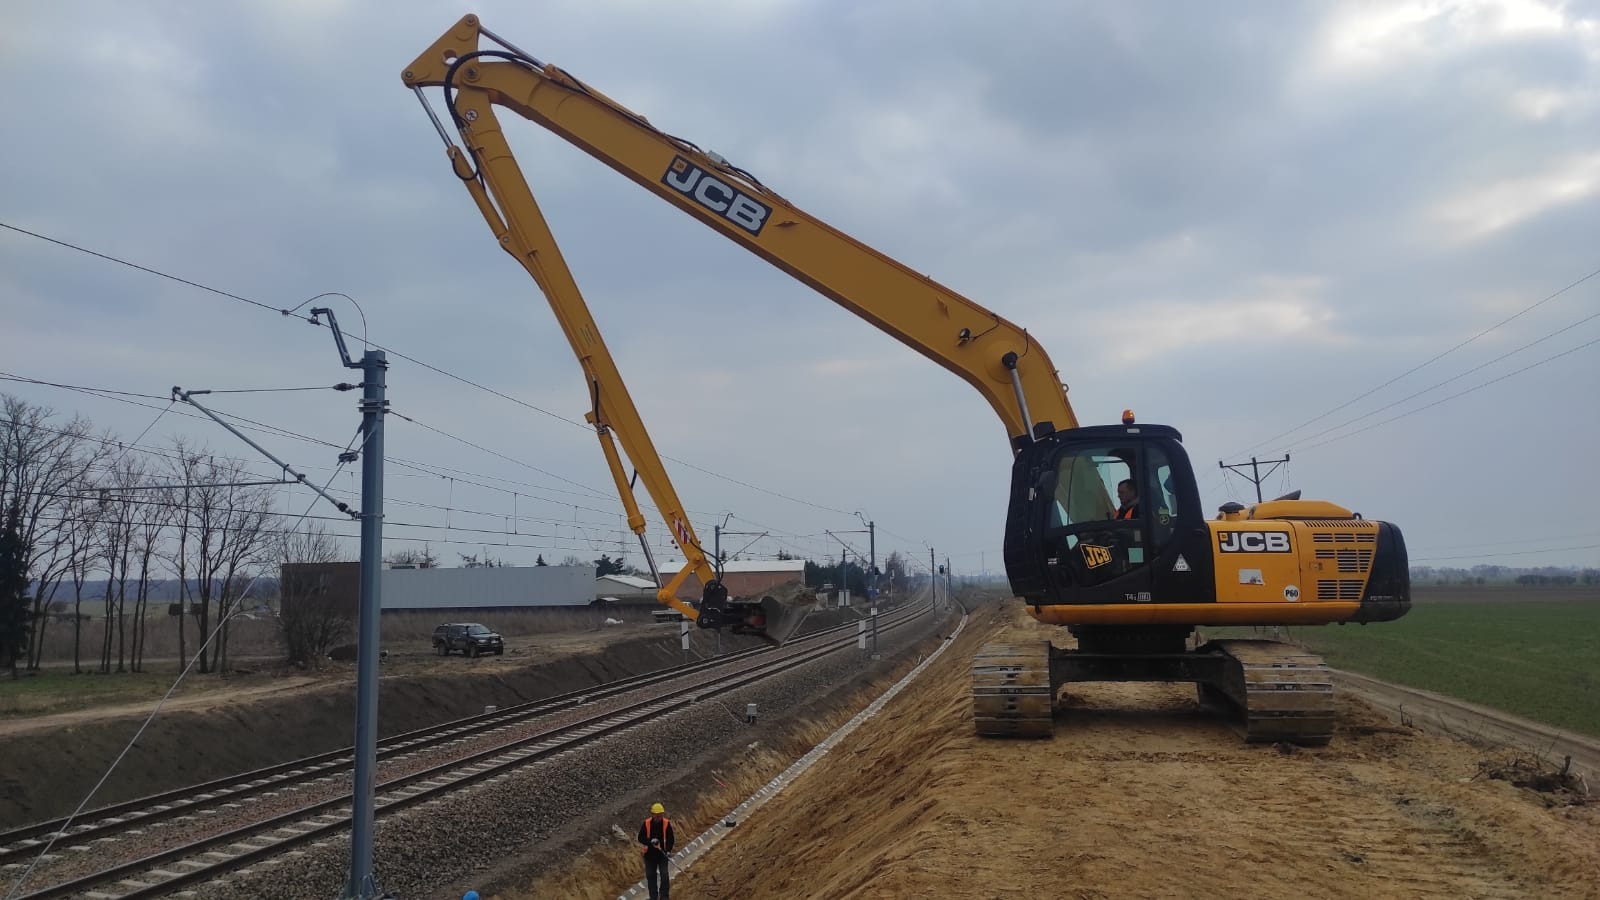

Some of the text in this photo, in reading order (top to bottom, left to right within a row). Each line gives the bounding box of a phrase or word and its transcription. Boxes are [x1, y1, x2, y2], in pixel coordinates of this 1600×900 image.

[666, 167, 767, 231] JCB
[1220, 532, 1290, 552] JCB
[1086, 546, 1111, 567] JCB
